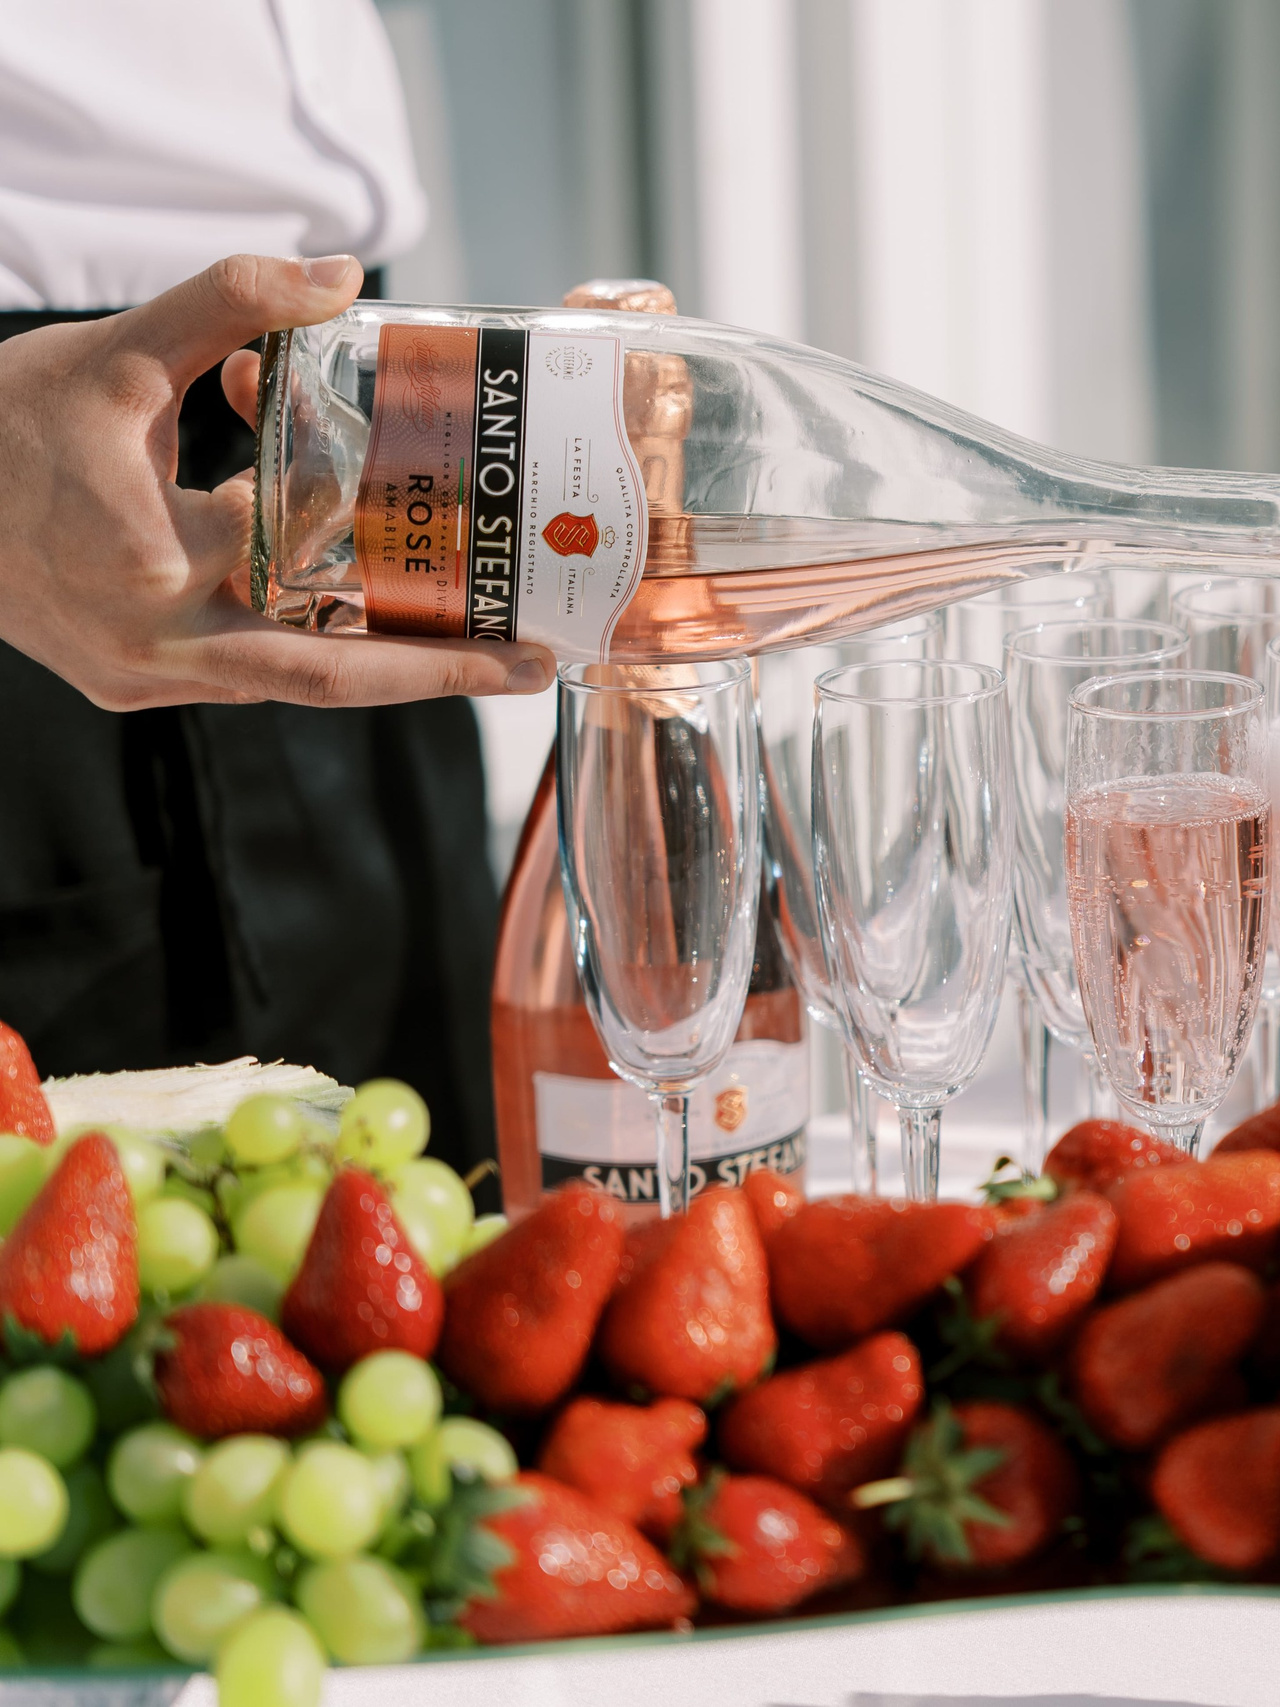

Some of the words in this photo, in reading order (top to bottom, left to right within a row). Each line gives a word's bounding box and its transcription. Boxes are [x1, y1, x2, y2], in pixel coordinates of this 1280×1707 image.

[443, 412, 452, 480] MIGLIOR
[479, 368, 519, 497] SANTO
[574, 437, 582, 453] LA
[529, 461, 539, 519] MARCHIO
[572, 458, 582, 498] FESTA
[615, 467, 632, 518] QUALITA
[383, 483, 398, 563] AMABILE
[405, 474, 437, 573] ROSÉ
[440, 490, 449, 572] COMPAGNO
[526, 524, 537, 595] REGISTRATO
[566, 568, 576, 615] ITALIANA
[609, 523, 634, 599] CONTROLLATA
[582, 1165, 707, 1201] SANO
